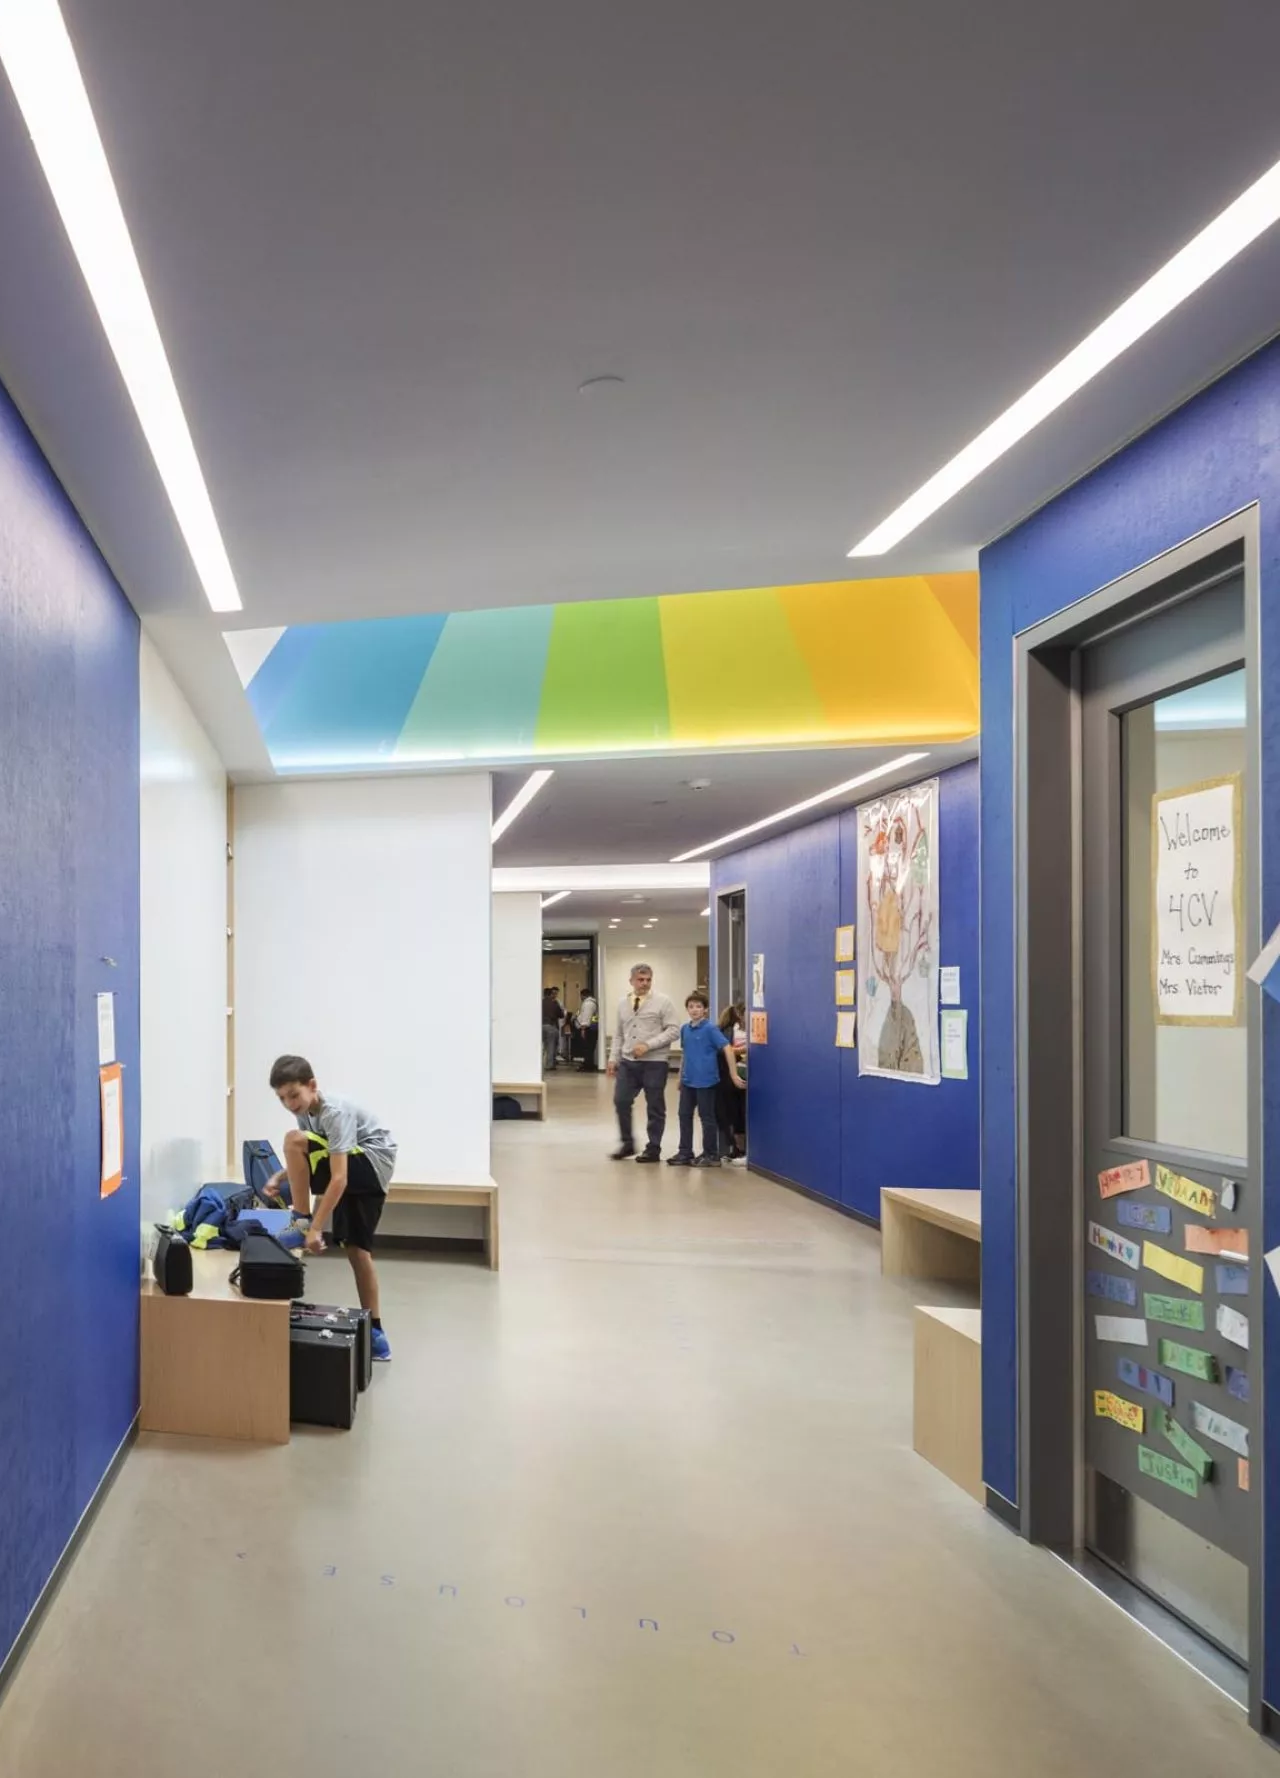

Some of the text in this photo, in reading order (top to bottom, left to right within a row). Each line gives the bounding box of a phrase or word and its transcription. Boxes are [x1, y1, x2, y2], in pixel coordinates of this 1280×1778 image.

[1160, 812, 1231, 851] Welcome
[1184, 862, 1200, 880] to
[1169, 889, 1219, 932] 4CV
[1185, 978, 1223, 996] Victor
[1141, 1449, 1195, 1492] Justin
